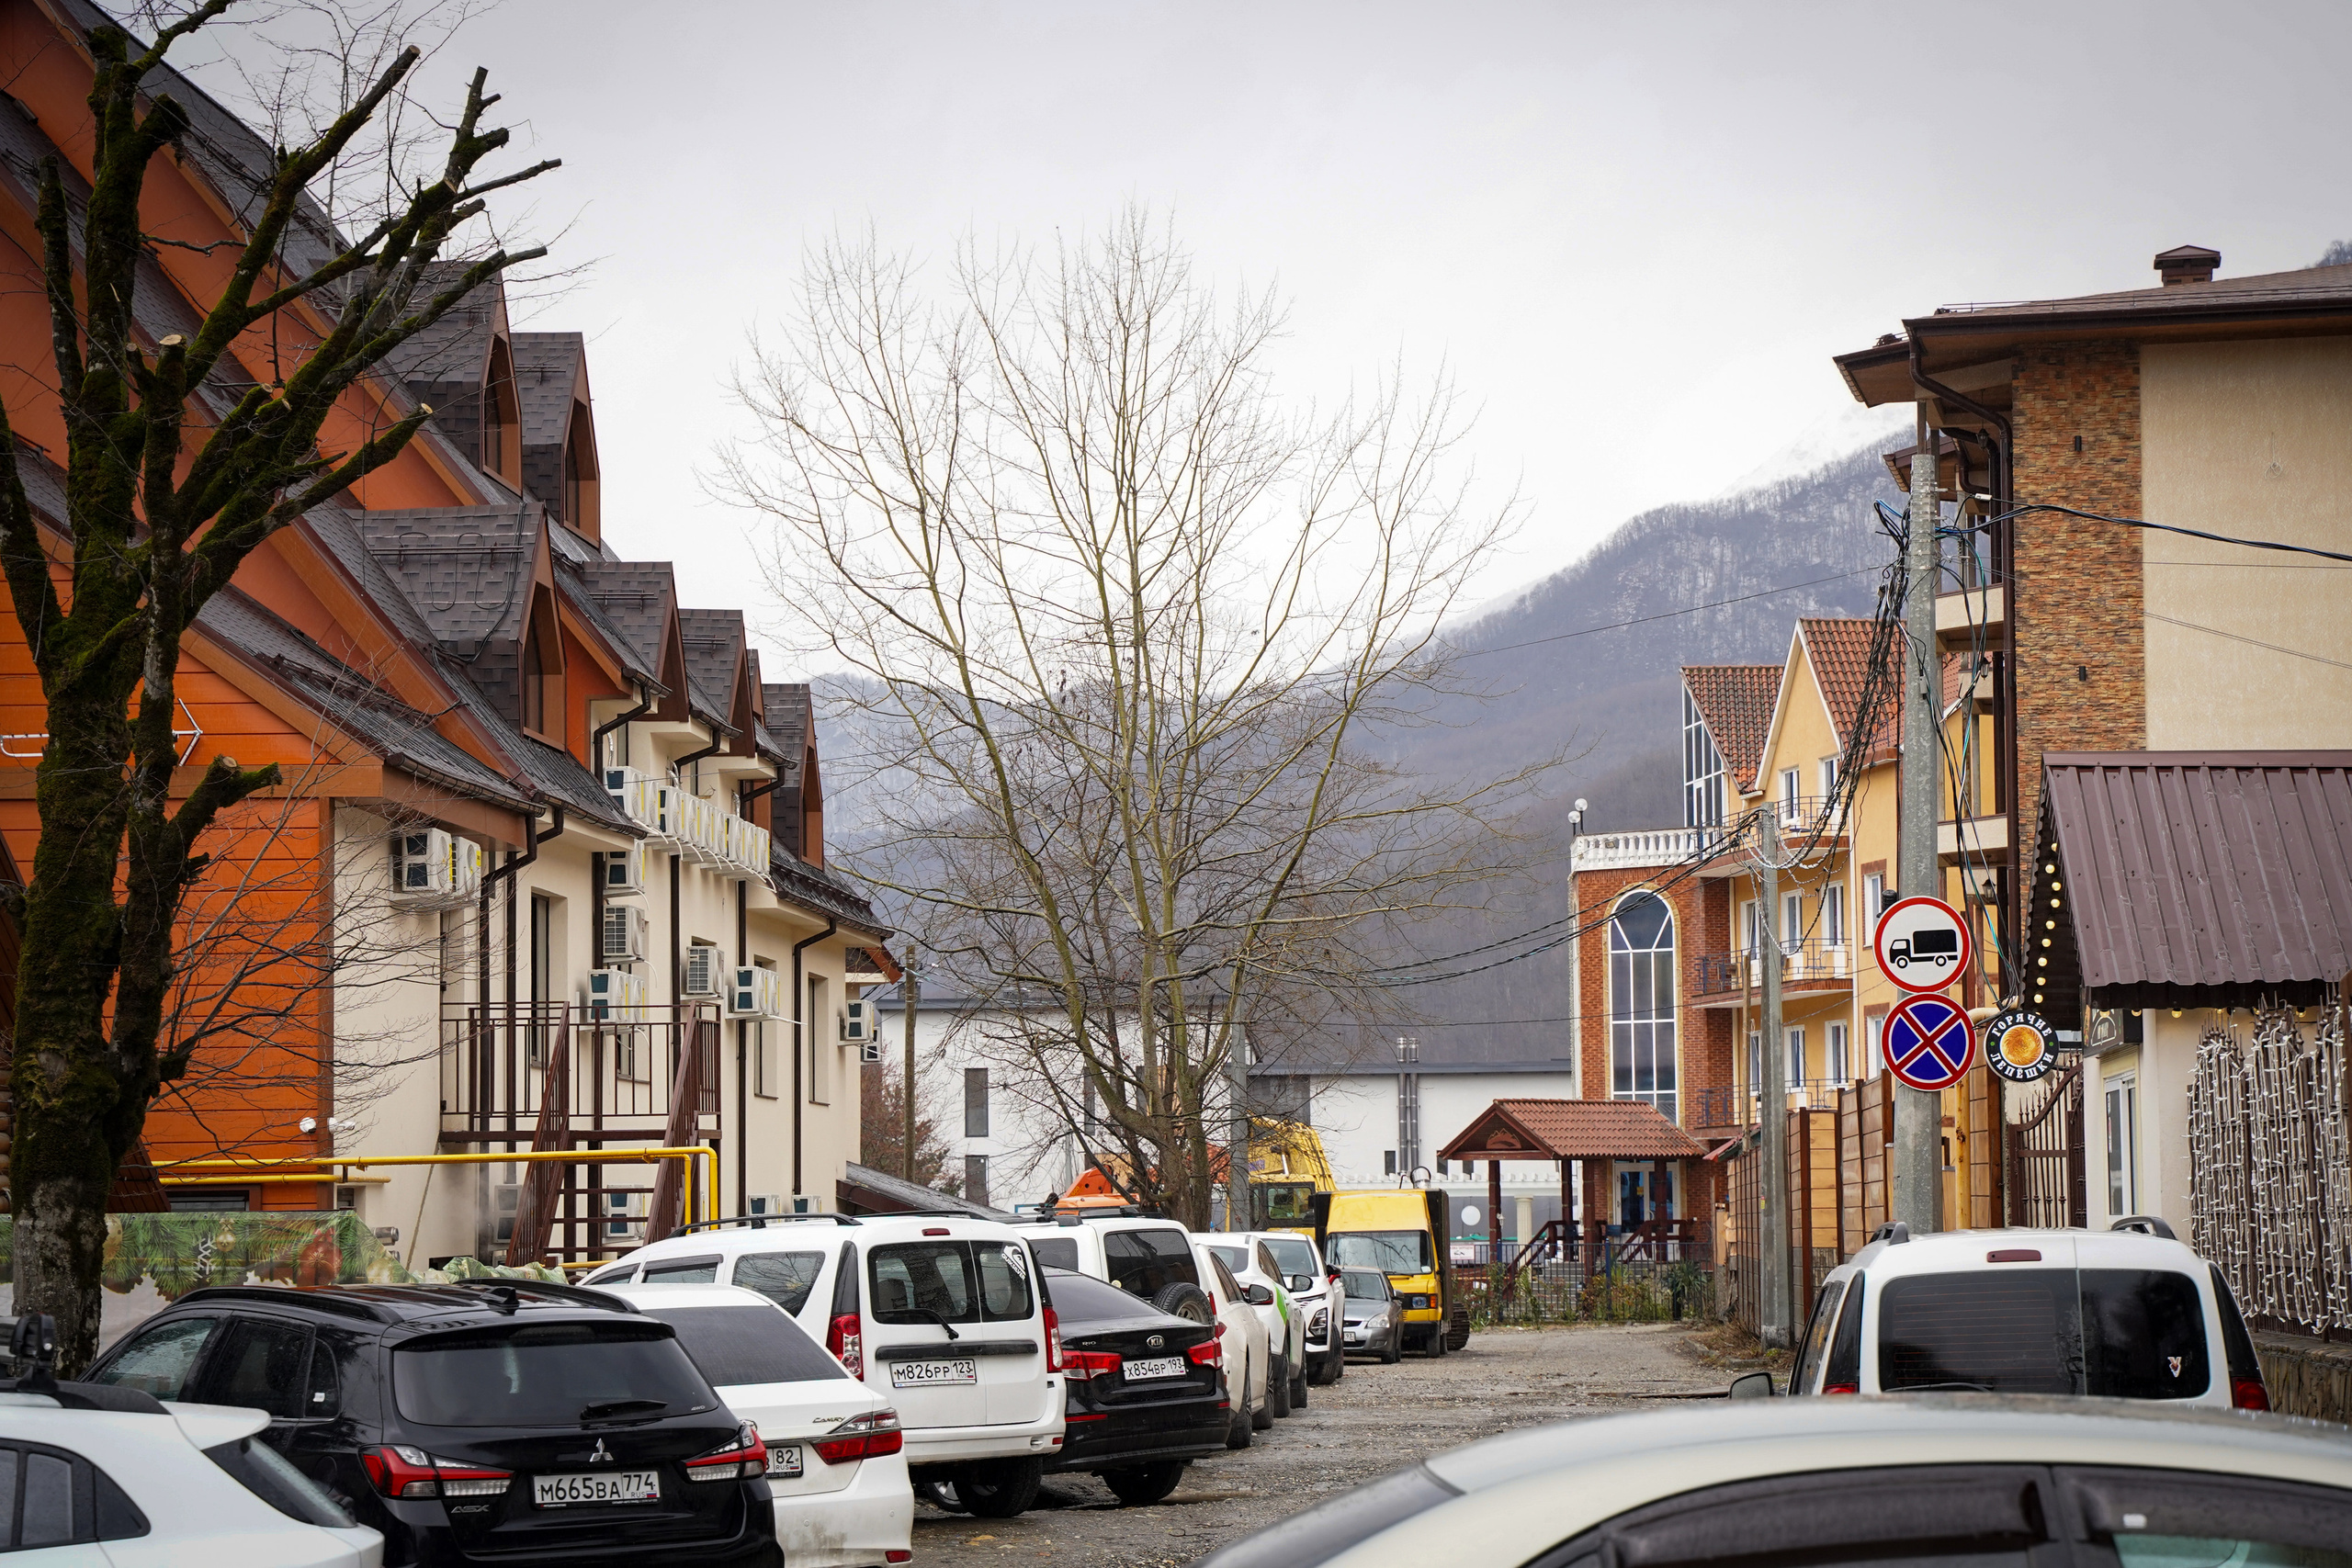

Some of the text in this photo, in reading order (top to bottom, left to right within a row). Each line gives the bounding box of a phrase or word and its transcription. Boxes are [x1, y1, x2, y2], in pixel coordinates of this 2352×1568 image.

[1992, 1013, 2052, 1037] ГОРЯЧИЕ
[1990, 1053, 2054, 1078] ЛЕПЁШКИ
[952, 1362, 972, 1374] 123
[1168, 1359, 1182, 1370] 193
[775, 1450, 794, 1464] 82
[623, 1473, 655, 1491] 774
[450, 1504, 491, 1514] ASX
